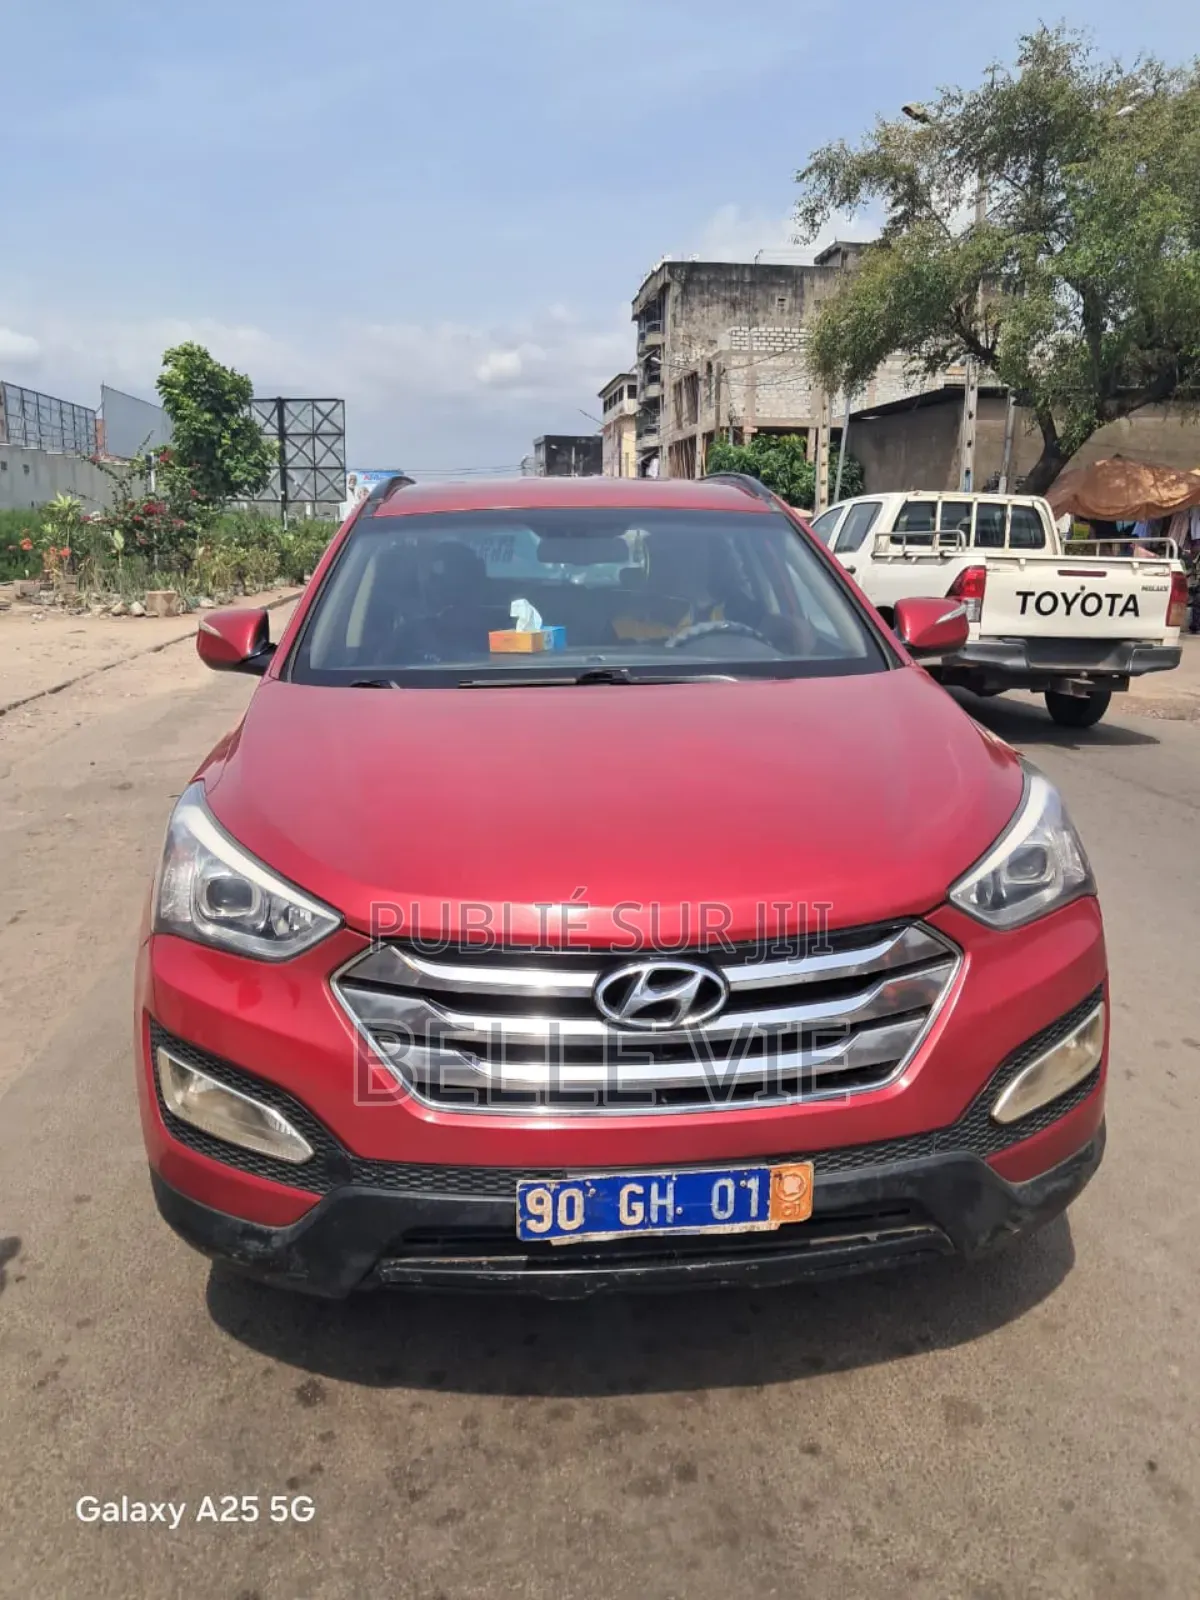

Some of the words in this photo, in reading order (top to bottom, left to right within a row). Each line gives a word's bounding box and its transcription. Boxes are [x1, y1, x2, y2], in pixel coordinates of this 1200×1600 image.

[1016, 591, 1140, 617] TOYOTA
[525, 1188, 585, 1234] 90
[619, 1180, 674, 1226] GH
[712, 1173, 760, 1220] 01
